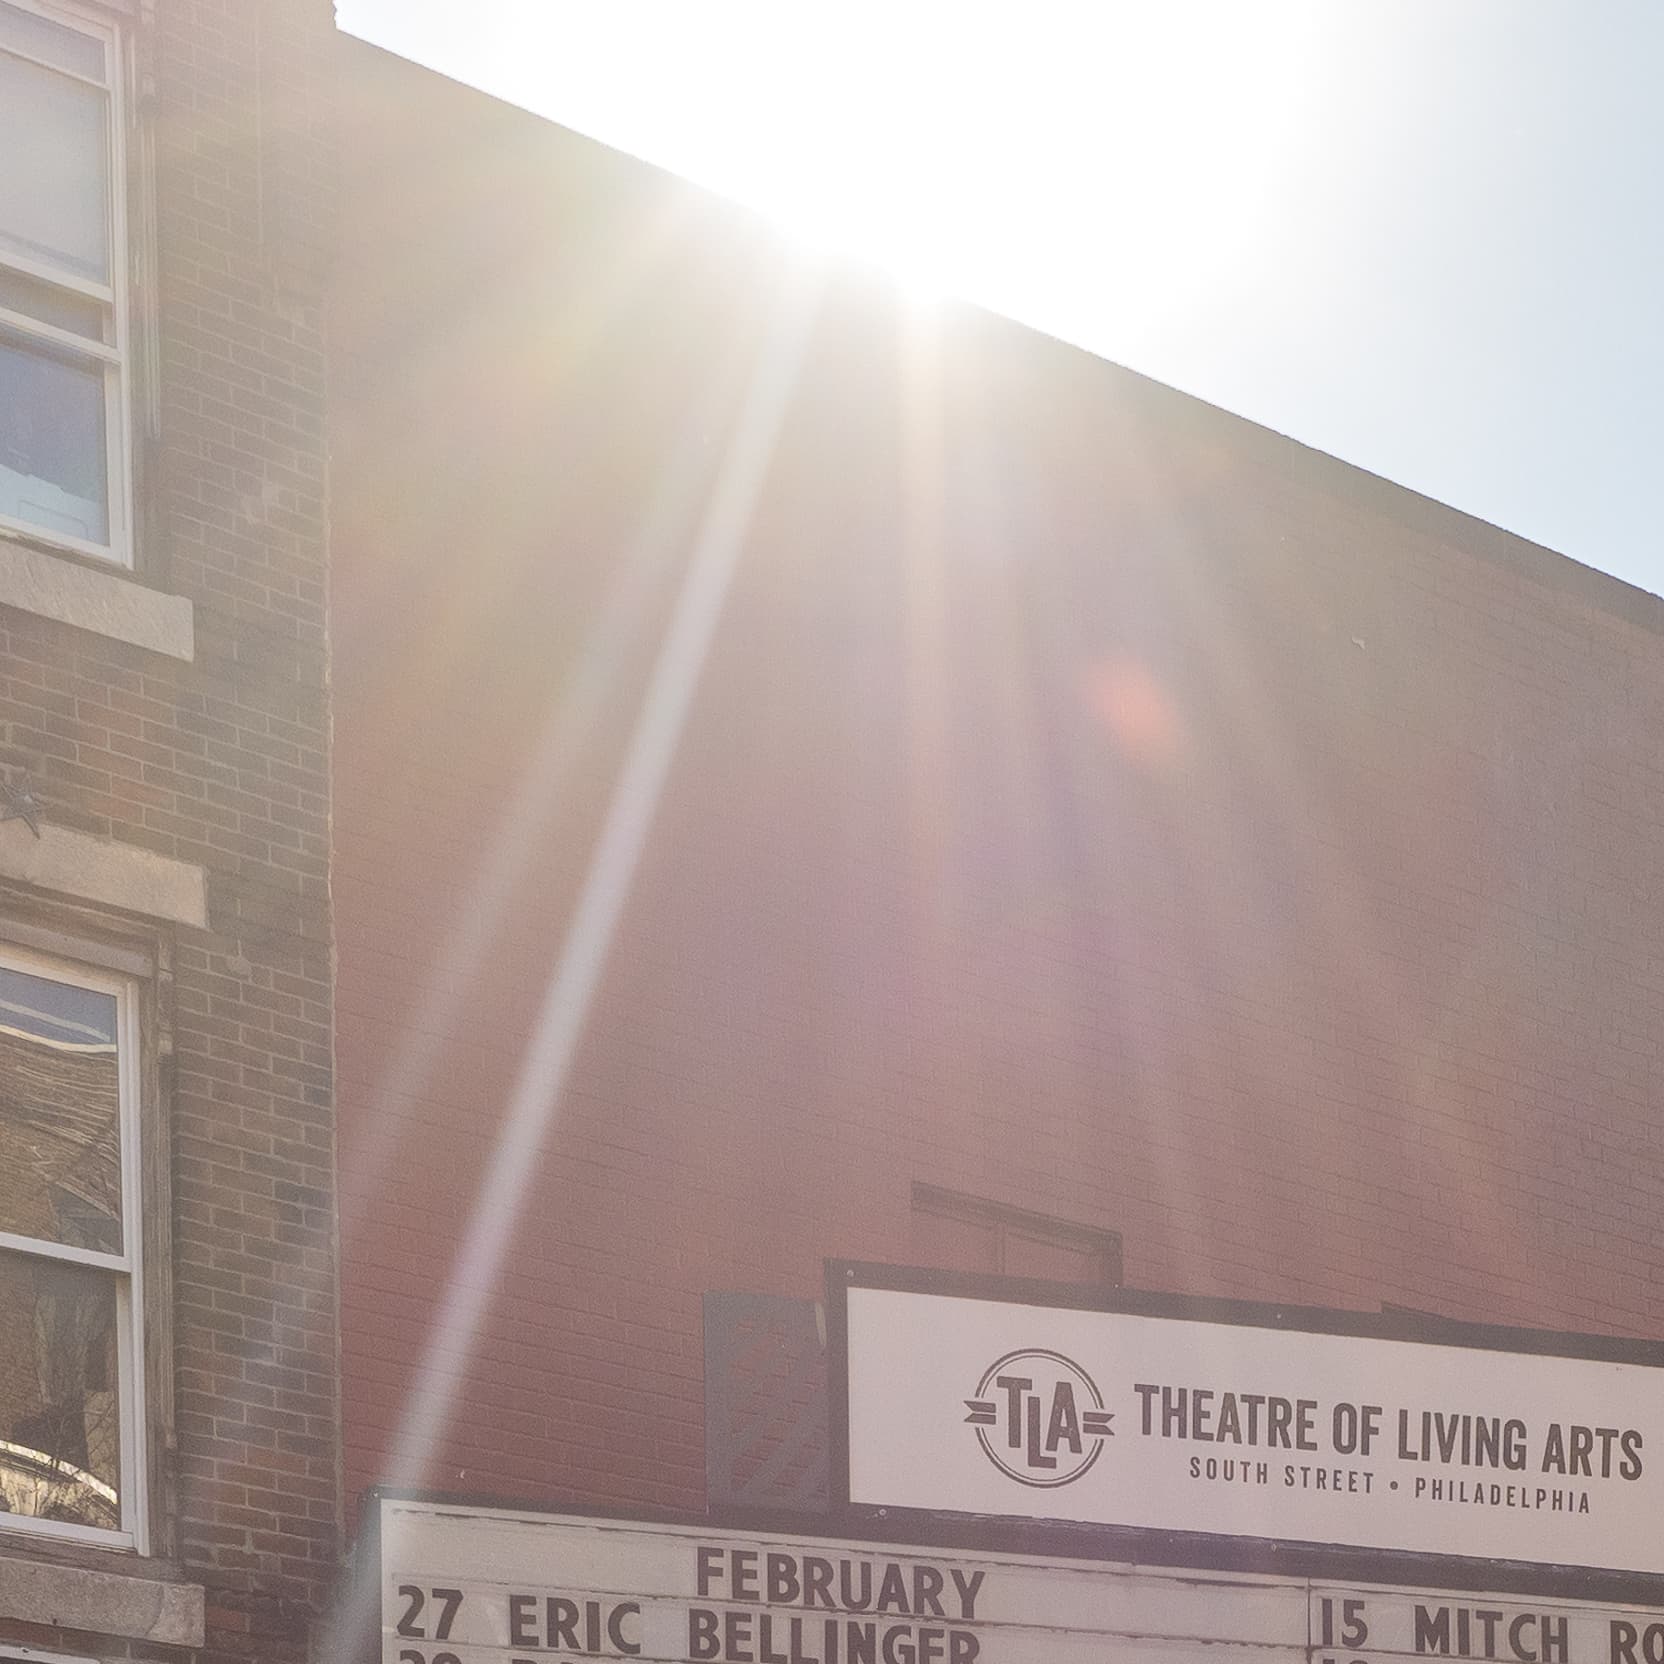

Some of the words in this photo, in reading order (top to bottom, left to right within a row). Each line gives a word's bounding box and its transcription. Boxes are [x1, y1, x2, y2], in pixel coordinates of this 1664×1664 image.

[997, 1376, 1082, 1469] TLA
[1134, 1383, 1317, 1451] THEATRE
[1332, 1402, 1380, 1455] OF
[1399, 1409, 1528, 1471] LIVING
[1542, 1424, 1643, 1481] ARTS
[1189, 1457, 1269, 1485] SOUTH
[1285, 1466, 1374, 1494] STREET
[1415, 1477, 1591, 1514] PHILADELPHIA
[696, 1546, 985, 1621] FEBRUARY
[397, 1585, 464, 1641] 27
[509, 1595, 641, 1655] ERIC
[1322, 1598, 1367, 1648] 15
[1415, 1605, 1569, 1664] MITCH
